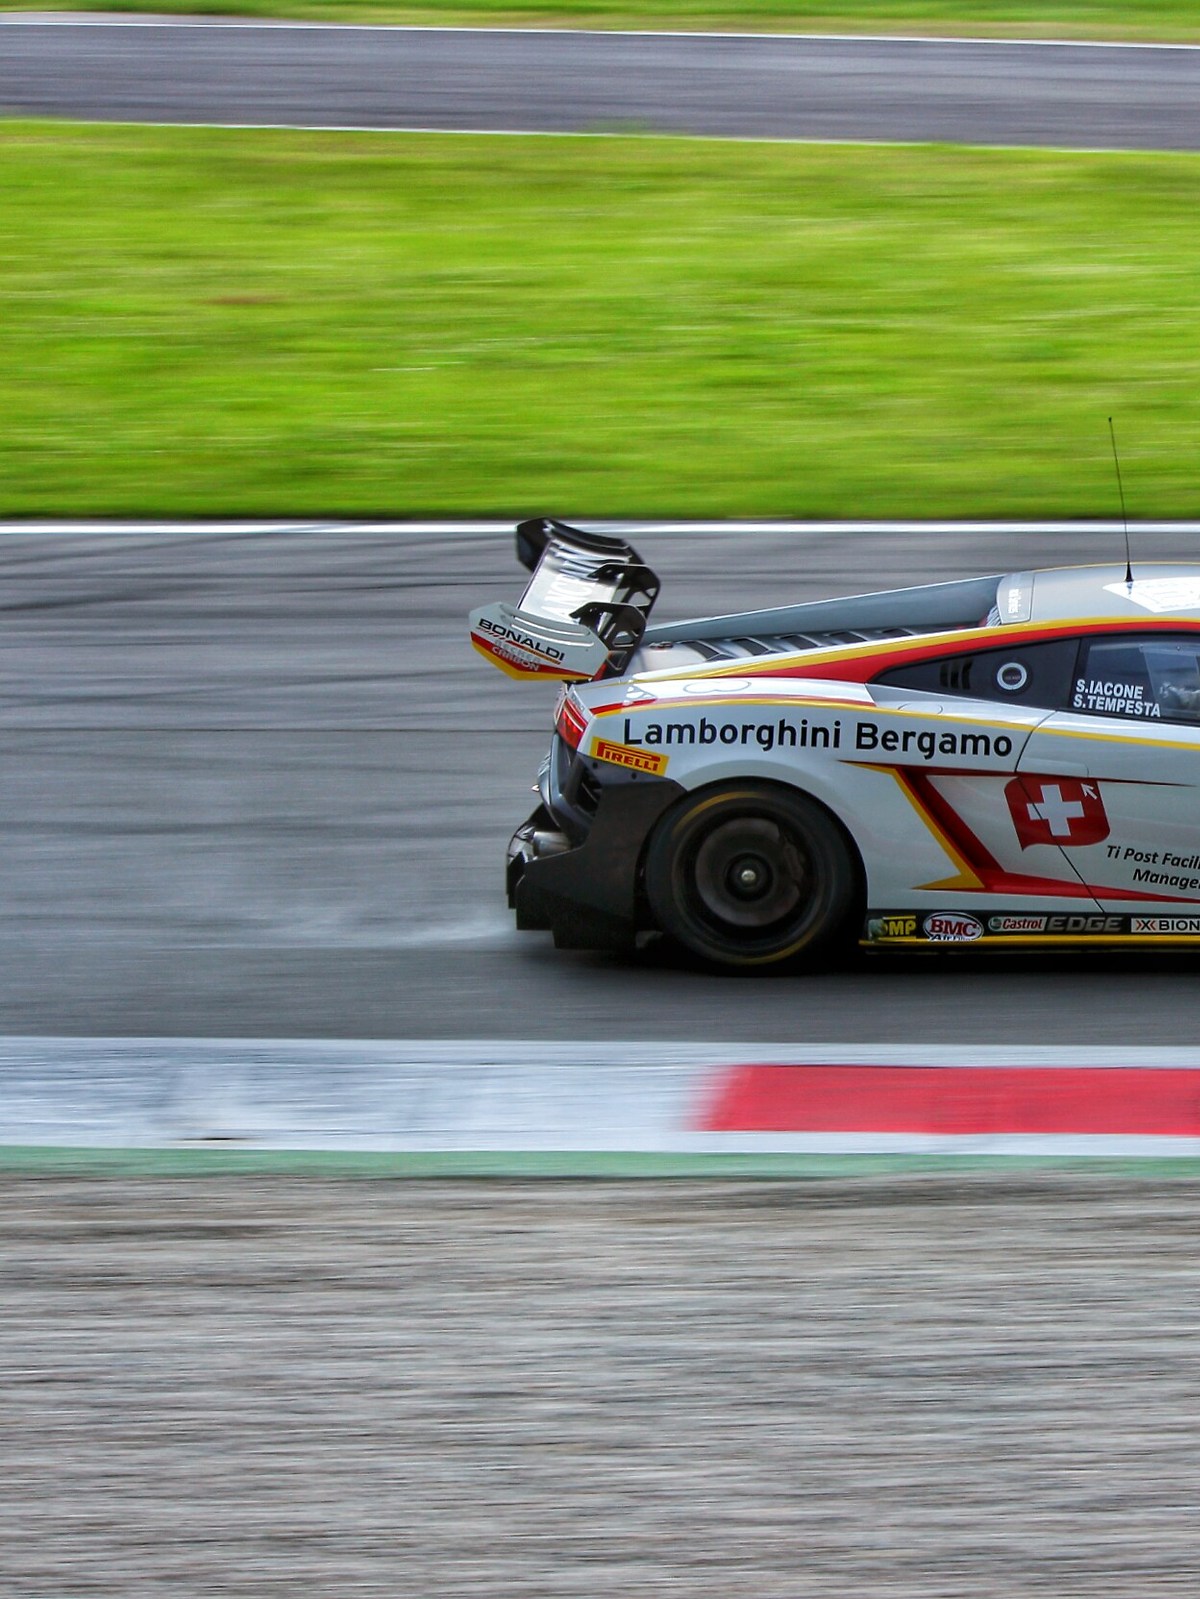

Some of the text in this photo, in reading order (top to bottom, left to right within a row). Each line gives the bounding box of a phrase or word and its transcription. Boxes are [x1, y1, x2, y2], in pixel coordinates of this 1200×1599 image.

[479, 619, 565, 660] BONALDI
[1076, 679, 1143, 699] S.IACONE
[1073, 694, 1160, 717] S.TEMPESTA
[623, 717, 1013, 760] Lamborghini Bergamo
[596, 741, 661, 771] PIRELLI
[1107, 845, 1121, 859] Ti
[1123, 848, 1159, 864] Post
[929, 918, 977, 937] BMC
[1002, 916, 1123, 932] Castrol EDGE
